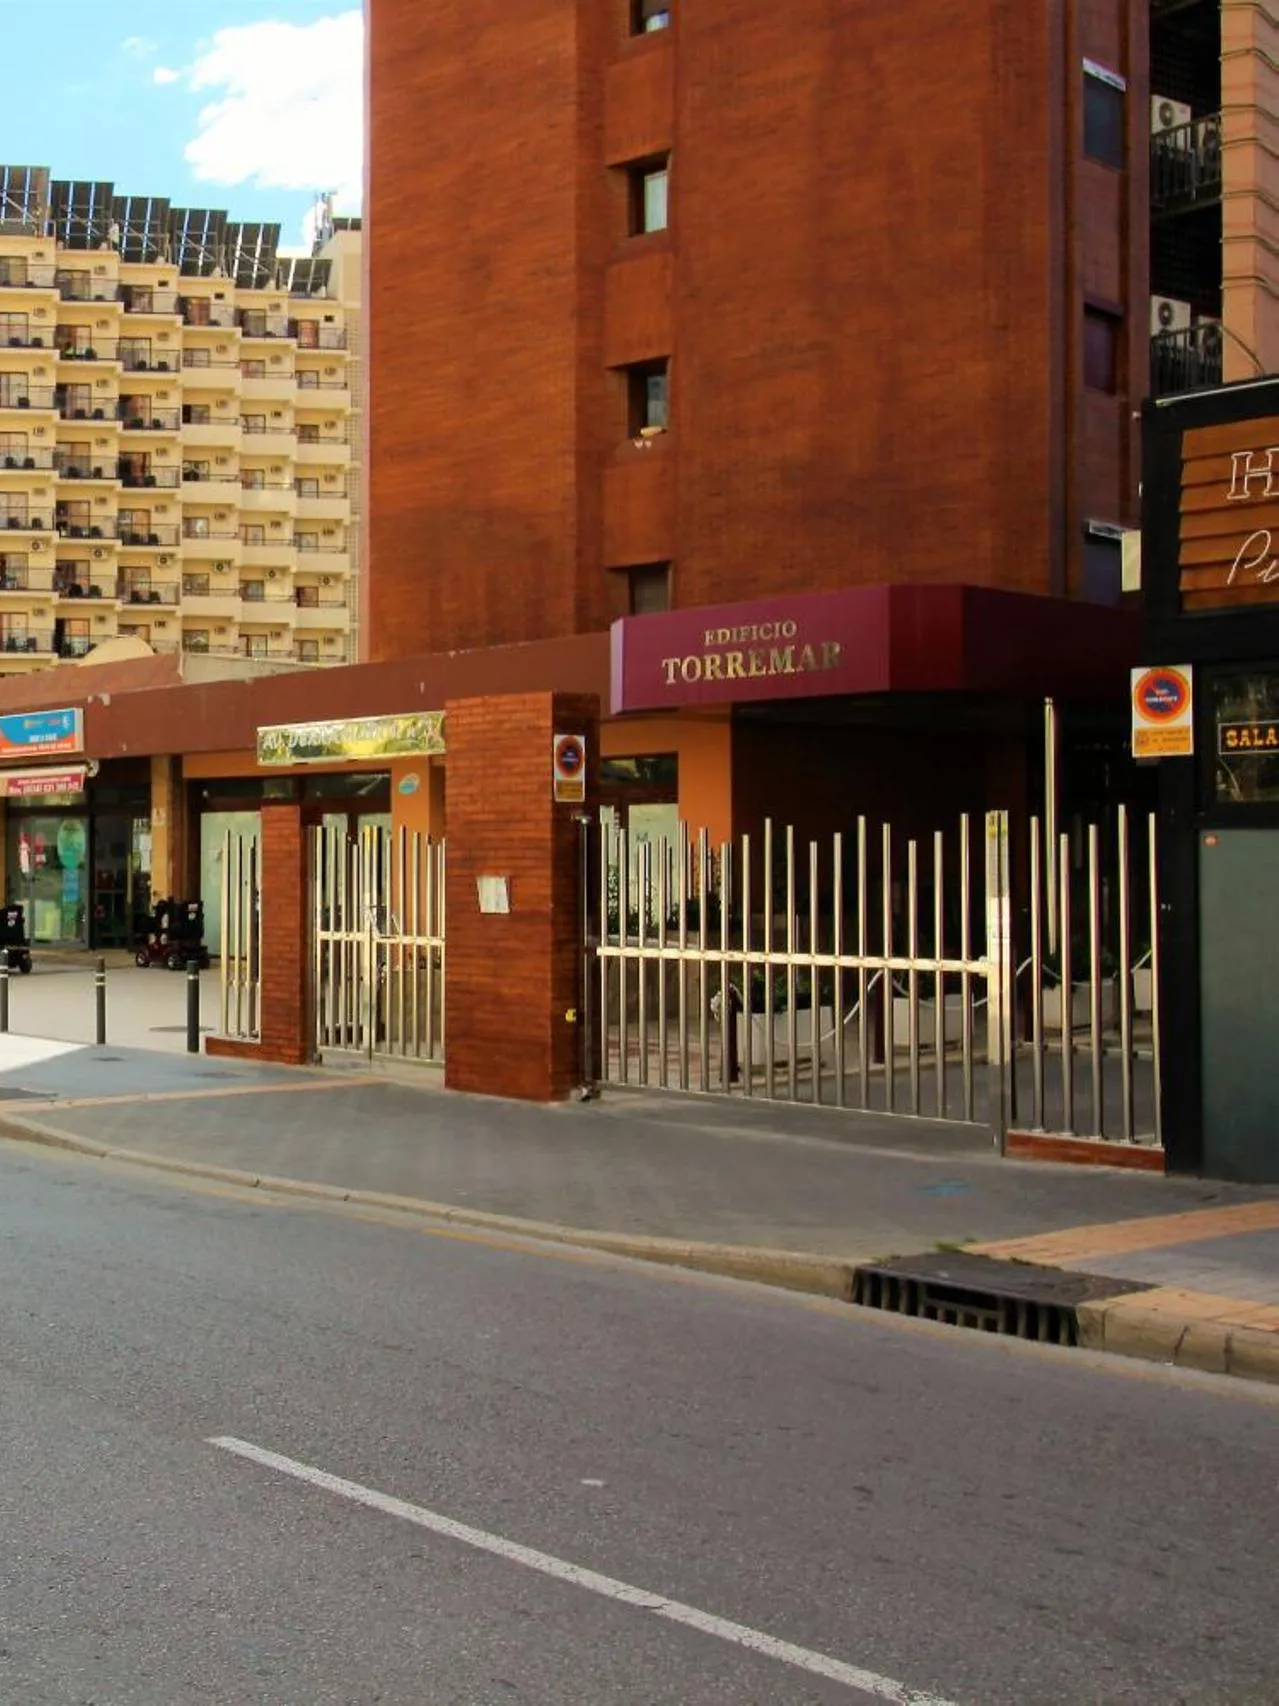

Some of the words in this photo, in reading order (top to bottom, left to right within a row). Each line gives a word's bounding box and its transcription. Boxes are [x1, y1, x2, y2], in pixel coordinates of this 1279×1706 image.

[705, 620, 797, 647] EDIFICIO
[662, 641, 842, 685] TORREMAR
[1226, 728, 1278, 748] SALA
